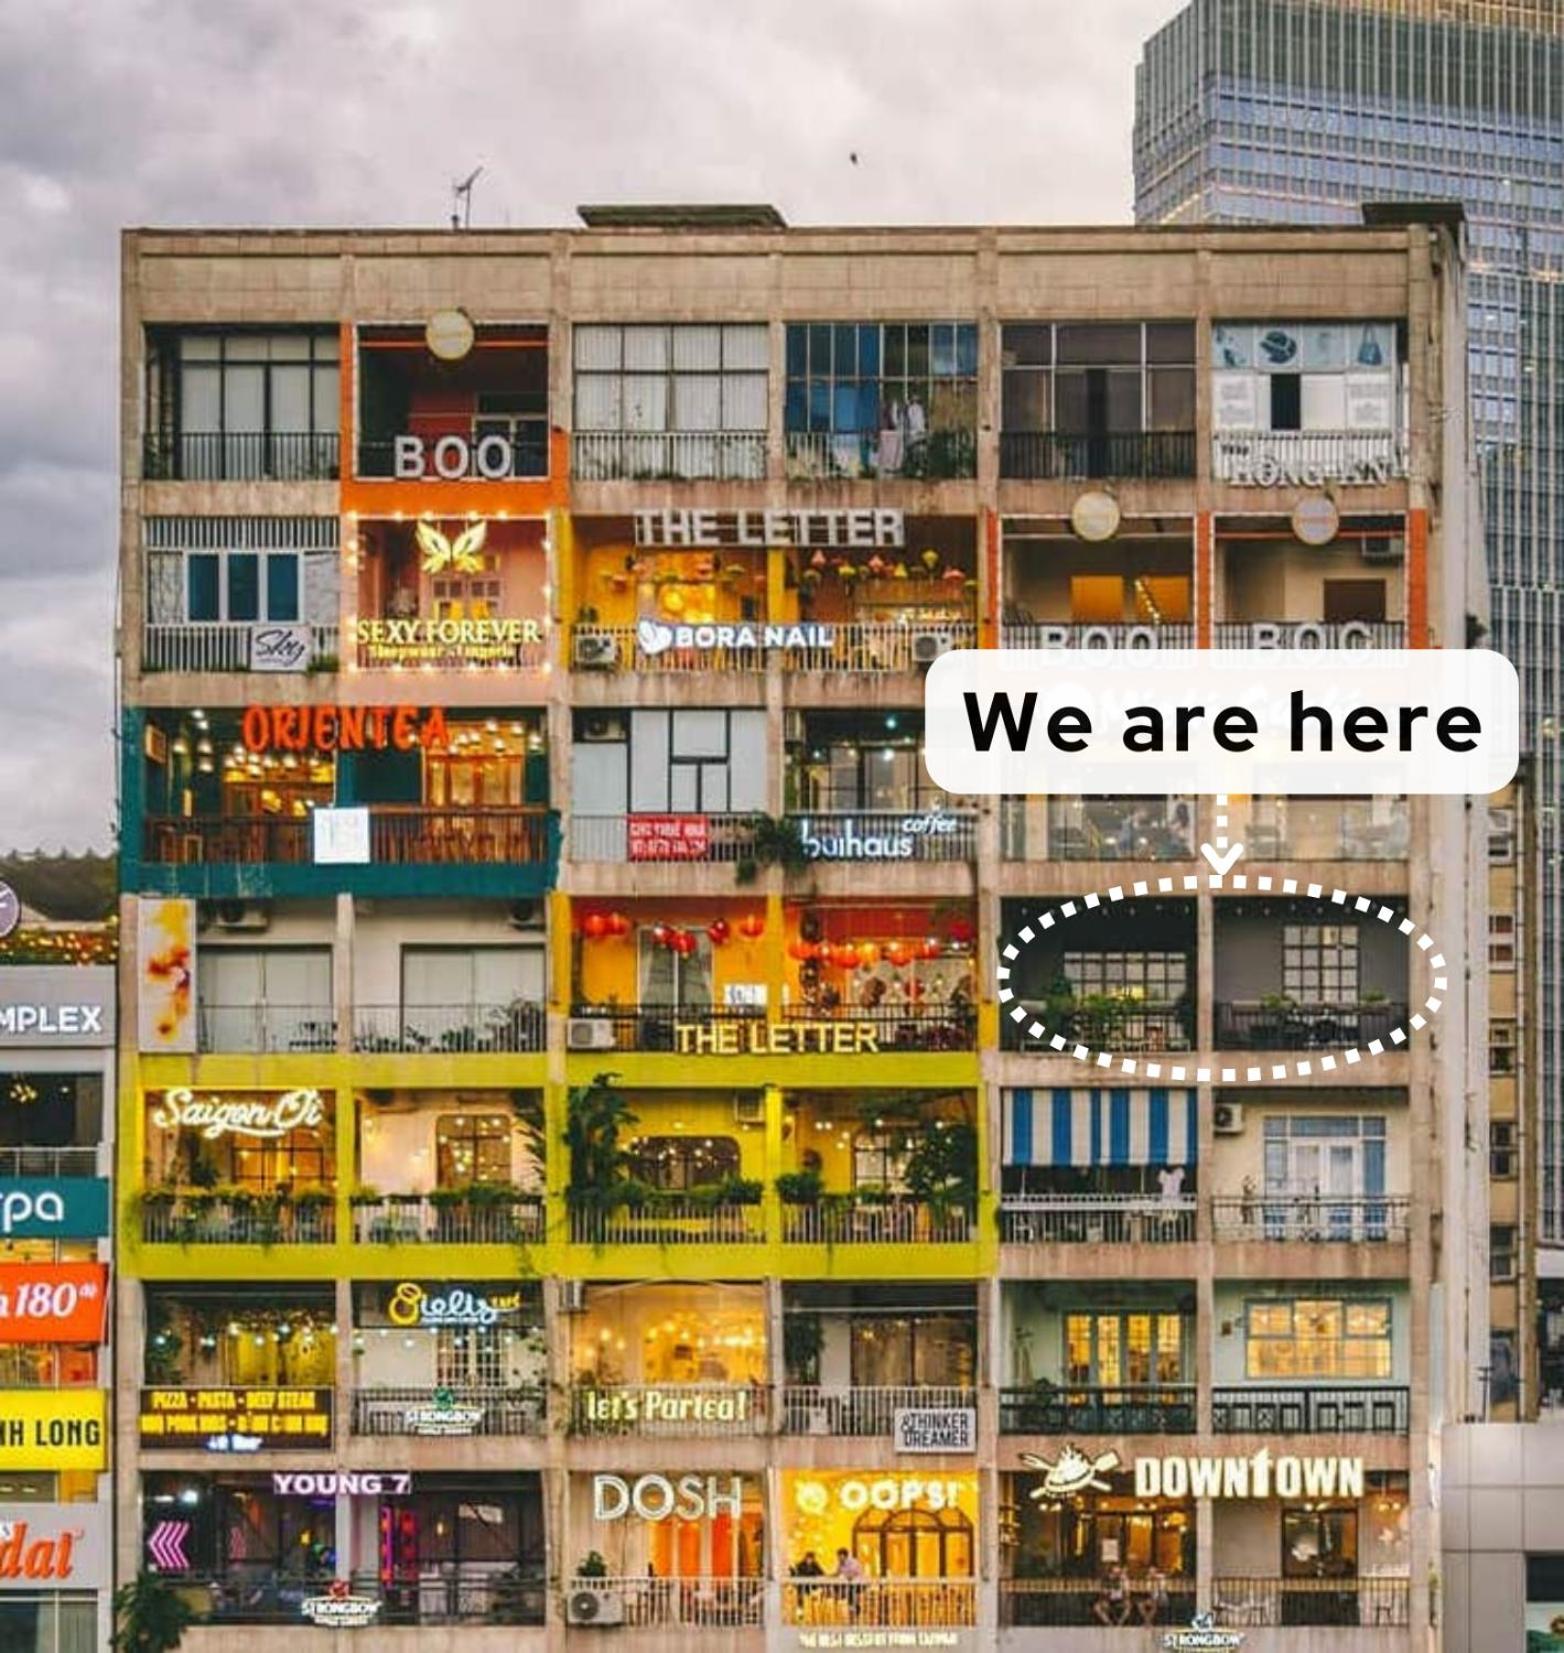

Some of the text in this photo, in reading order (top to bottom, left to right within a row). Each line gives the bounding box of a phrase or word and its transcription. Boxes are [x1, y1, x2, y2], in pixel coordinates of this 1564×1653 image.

[394, 435, 512, 479] BOO
[634, 508, 905, 546] THE LETTER
[356, 619, 542, 644] SEXY FOREVER
[676, 626, 834, 648] BORA NAIL
[242, 703, 451, 751] ORIENTEA
[902, 812, 958, 835] coffee
[675, 1022, 880, 1054] THE LETTER
[153, 1088, 280, 1139] Saigon
[0, 1191, 65, 1233] pa
[15, 1281, 78, 1318] 180
[36, 1419, 100, 1446] LONG
[911, 1413, 969, 1429] THINKER
[904, 1430, 969, 1447] DREAMER
[273, 1473, 409, 1495] YOUNG 7
[594, 1473, 741, 1521] DOSH
